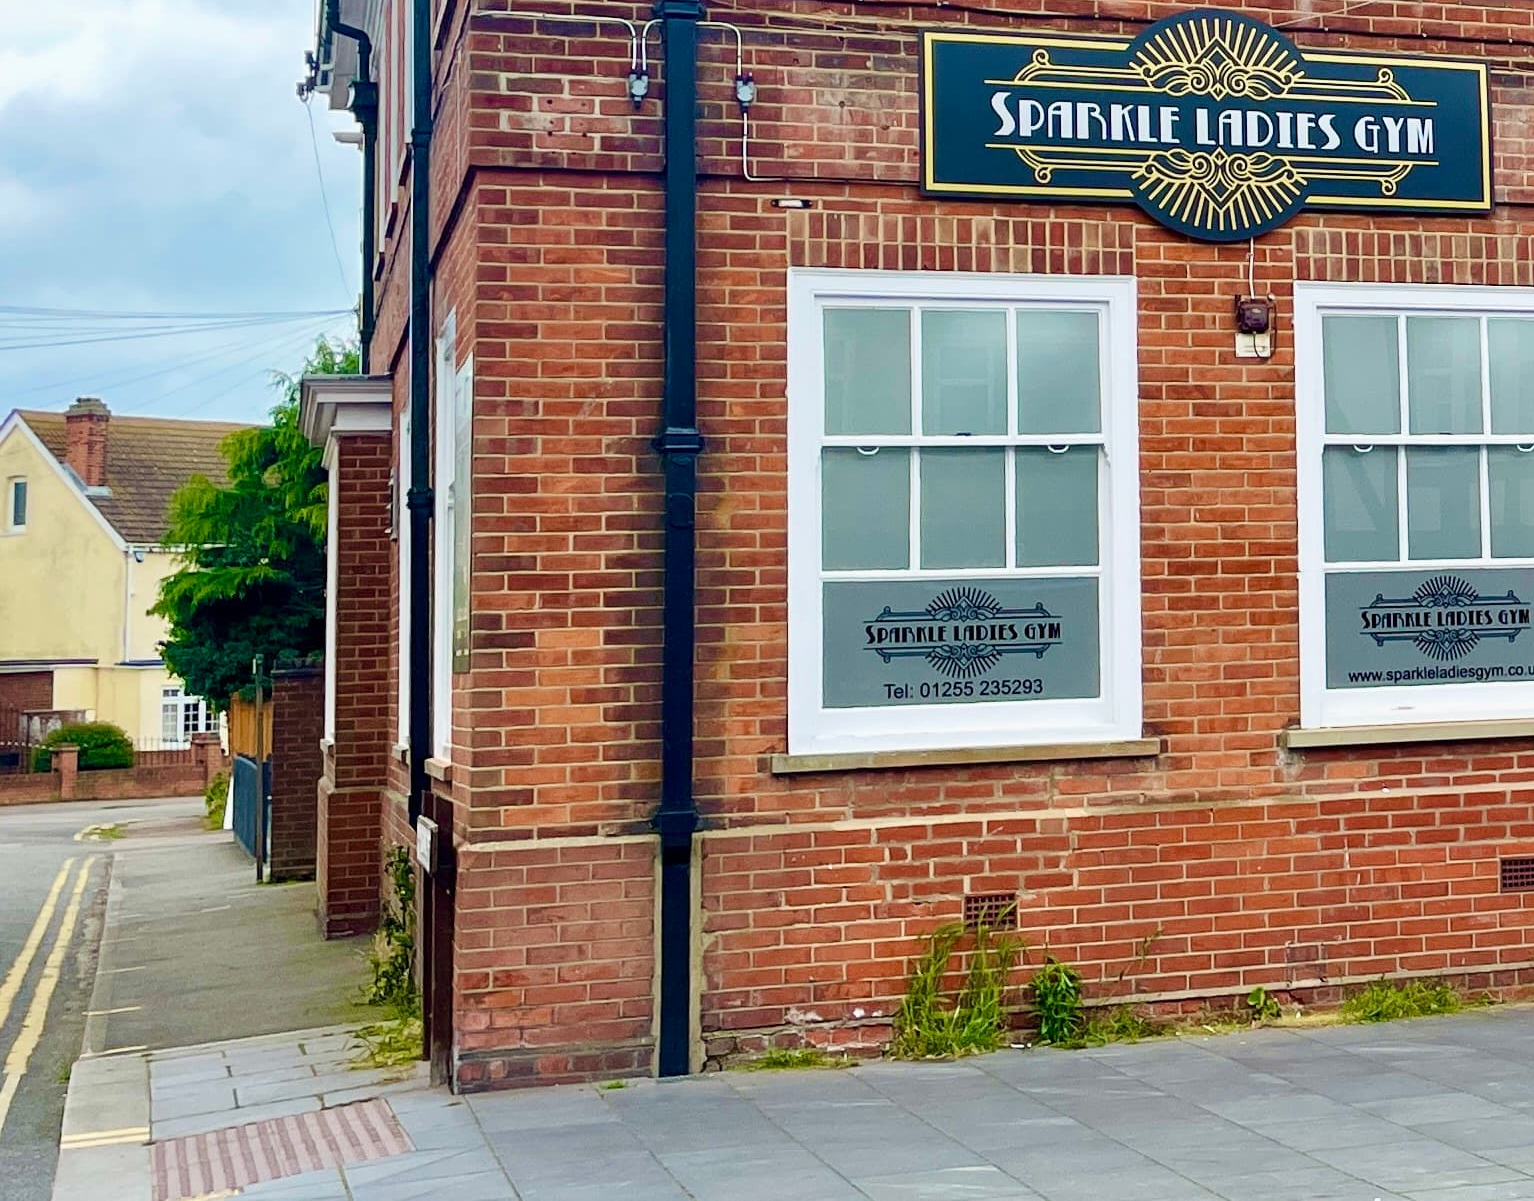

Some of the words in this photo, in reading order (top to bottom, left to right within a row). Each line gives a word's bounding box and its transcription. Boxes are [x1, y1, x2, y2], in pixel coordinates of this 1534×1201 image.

[991, 91, 1180, 144] SPARKLE
[1196, 108, 1341, 150] LADIES
[1354, 116, 1434, 154] GYM
[1360, 610, 1432, 629] SPARKLE
[1437, 610, 1493, 628] LADIES
[1498, 608, 1530, 625] GYM
[865, 623, 947, 645] SPARKLE
[953, 624, 1018, 641] LADIES
[1024, 622, 1061, 640] GYM
[883, 682, 914, 700] Tel:
[920, 680, 974, 699] 01255
[979, 678, 1044, 696] 235293
